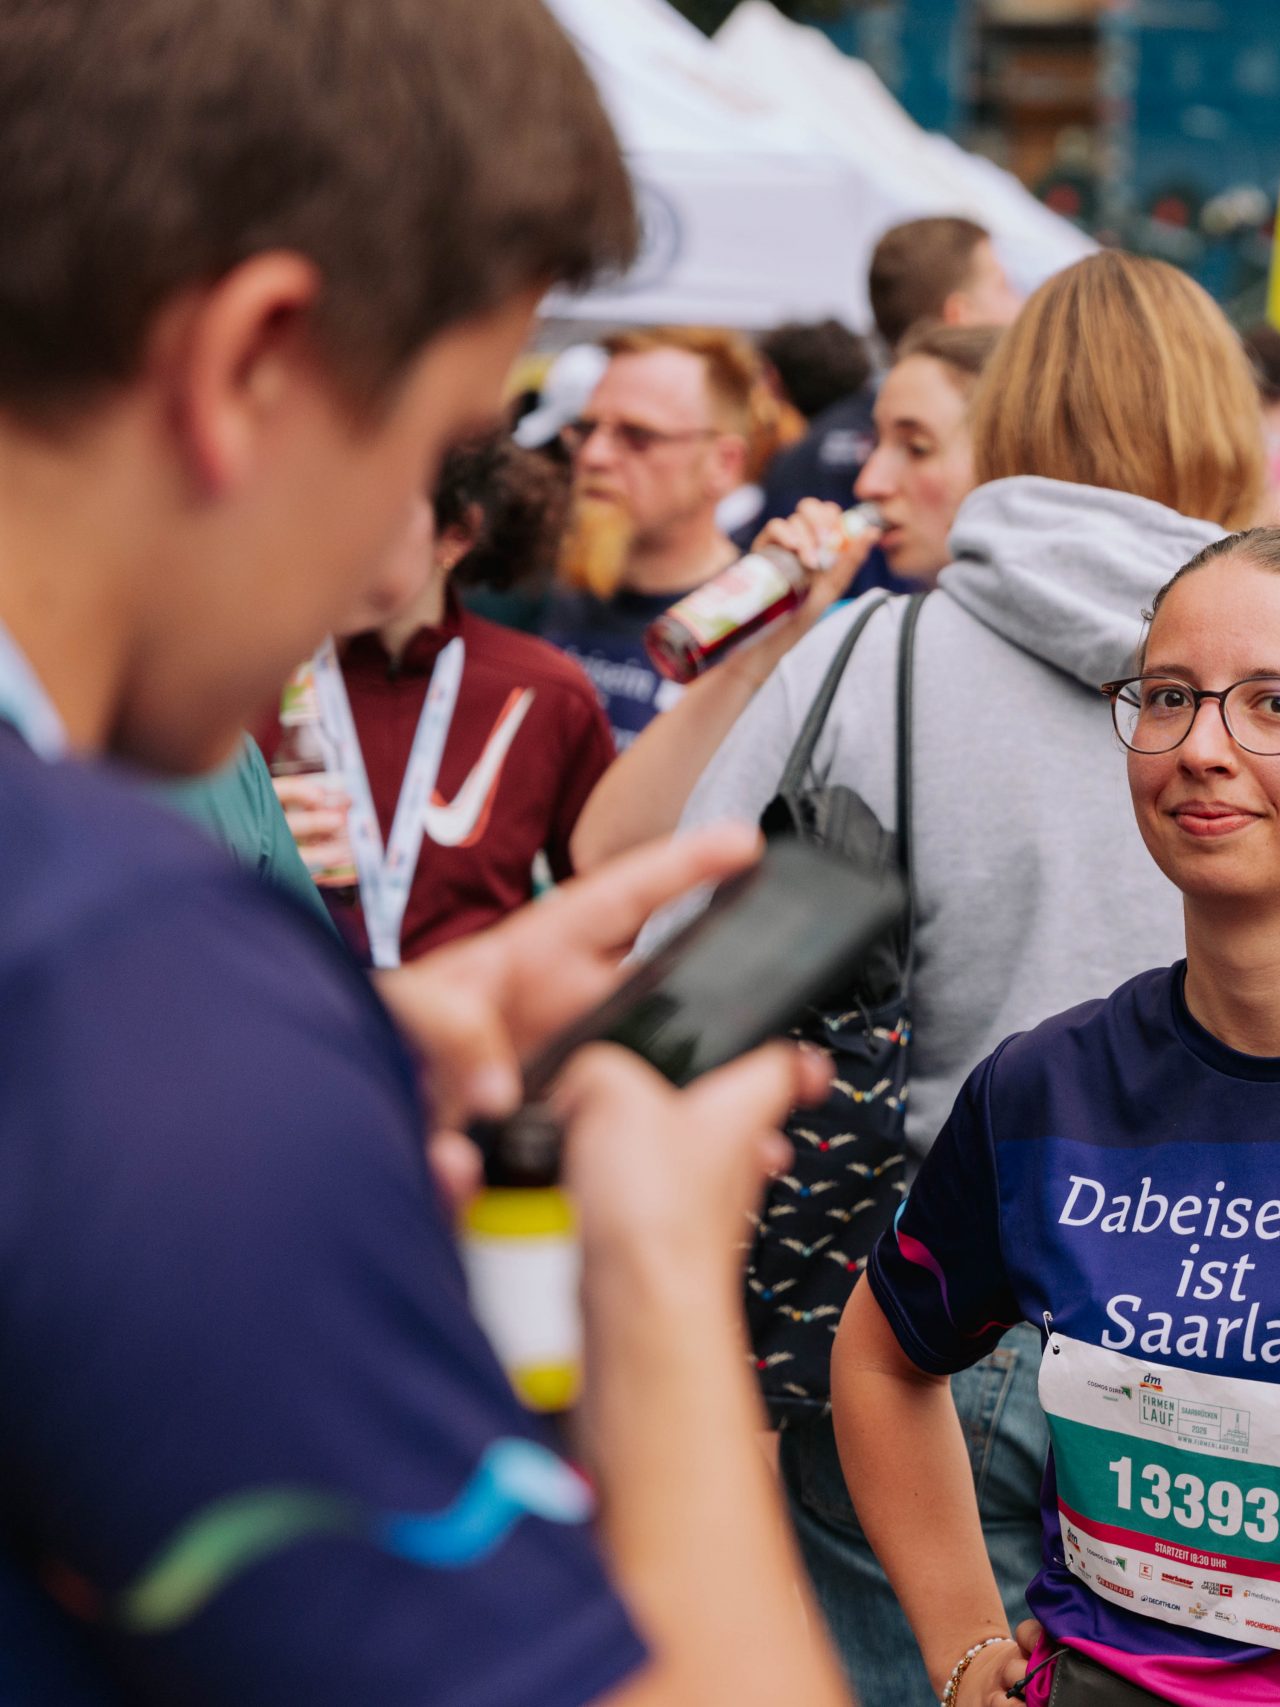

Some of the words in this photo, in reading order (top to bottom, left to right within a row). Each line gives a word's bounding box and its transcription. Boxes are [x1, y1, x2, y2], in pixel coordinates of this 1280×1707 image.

[1176, 1244, 1255, 1302] ist
[1143, 1373, 1161, 1386] dm
[1142, 1395, 1175, 1411] FIRMEN
[1143, 1407, 1174, 1427] LAUF
[1181, 1407, 1218, 1420] SAARBRÜCKEN
[1109, 1456, 1280, 1543] 13393
[1154, 1542, 1189, 1561] STARTZEIT
[1190, 1553, 1209, 1566] 18:30
[1210, 1557, 1227, 1569] UHR
[1148, 1597, 1181, 1611] DECATHLON
